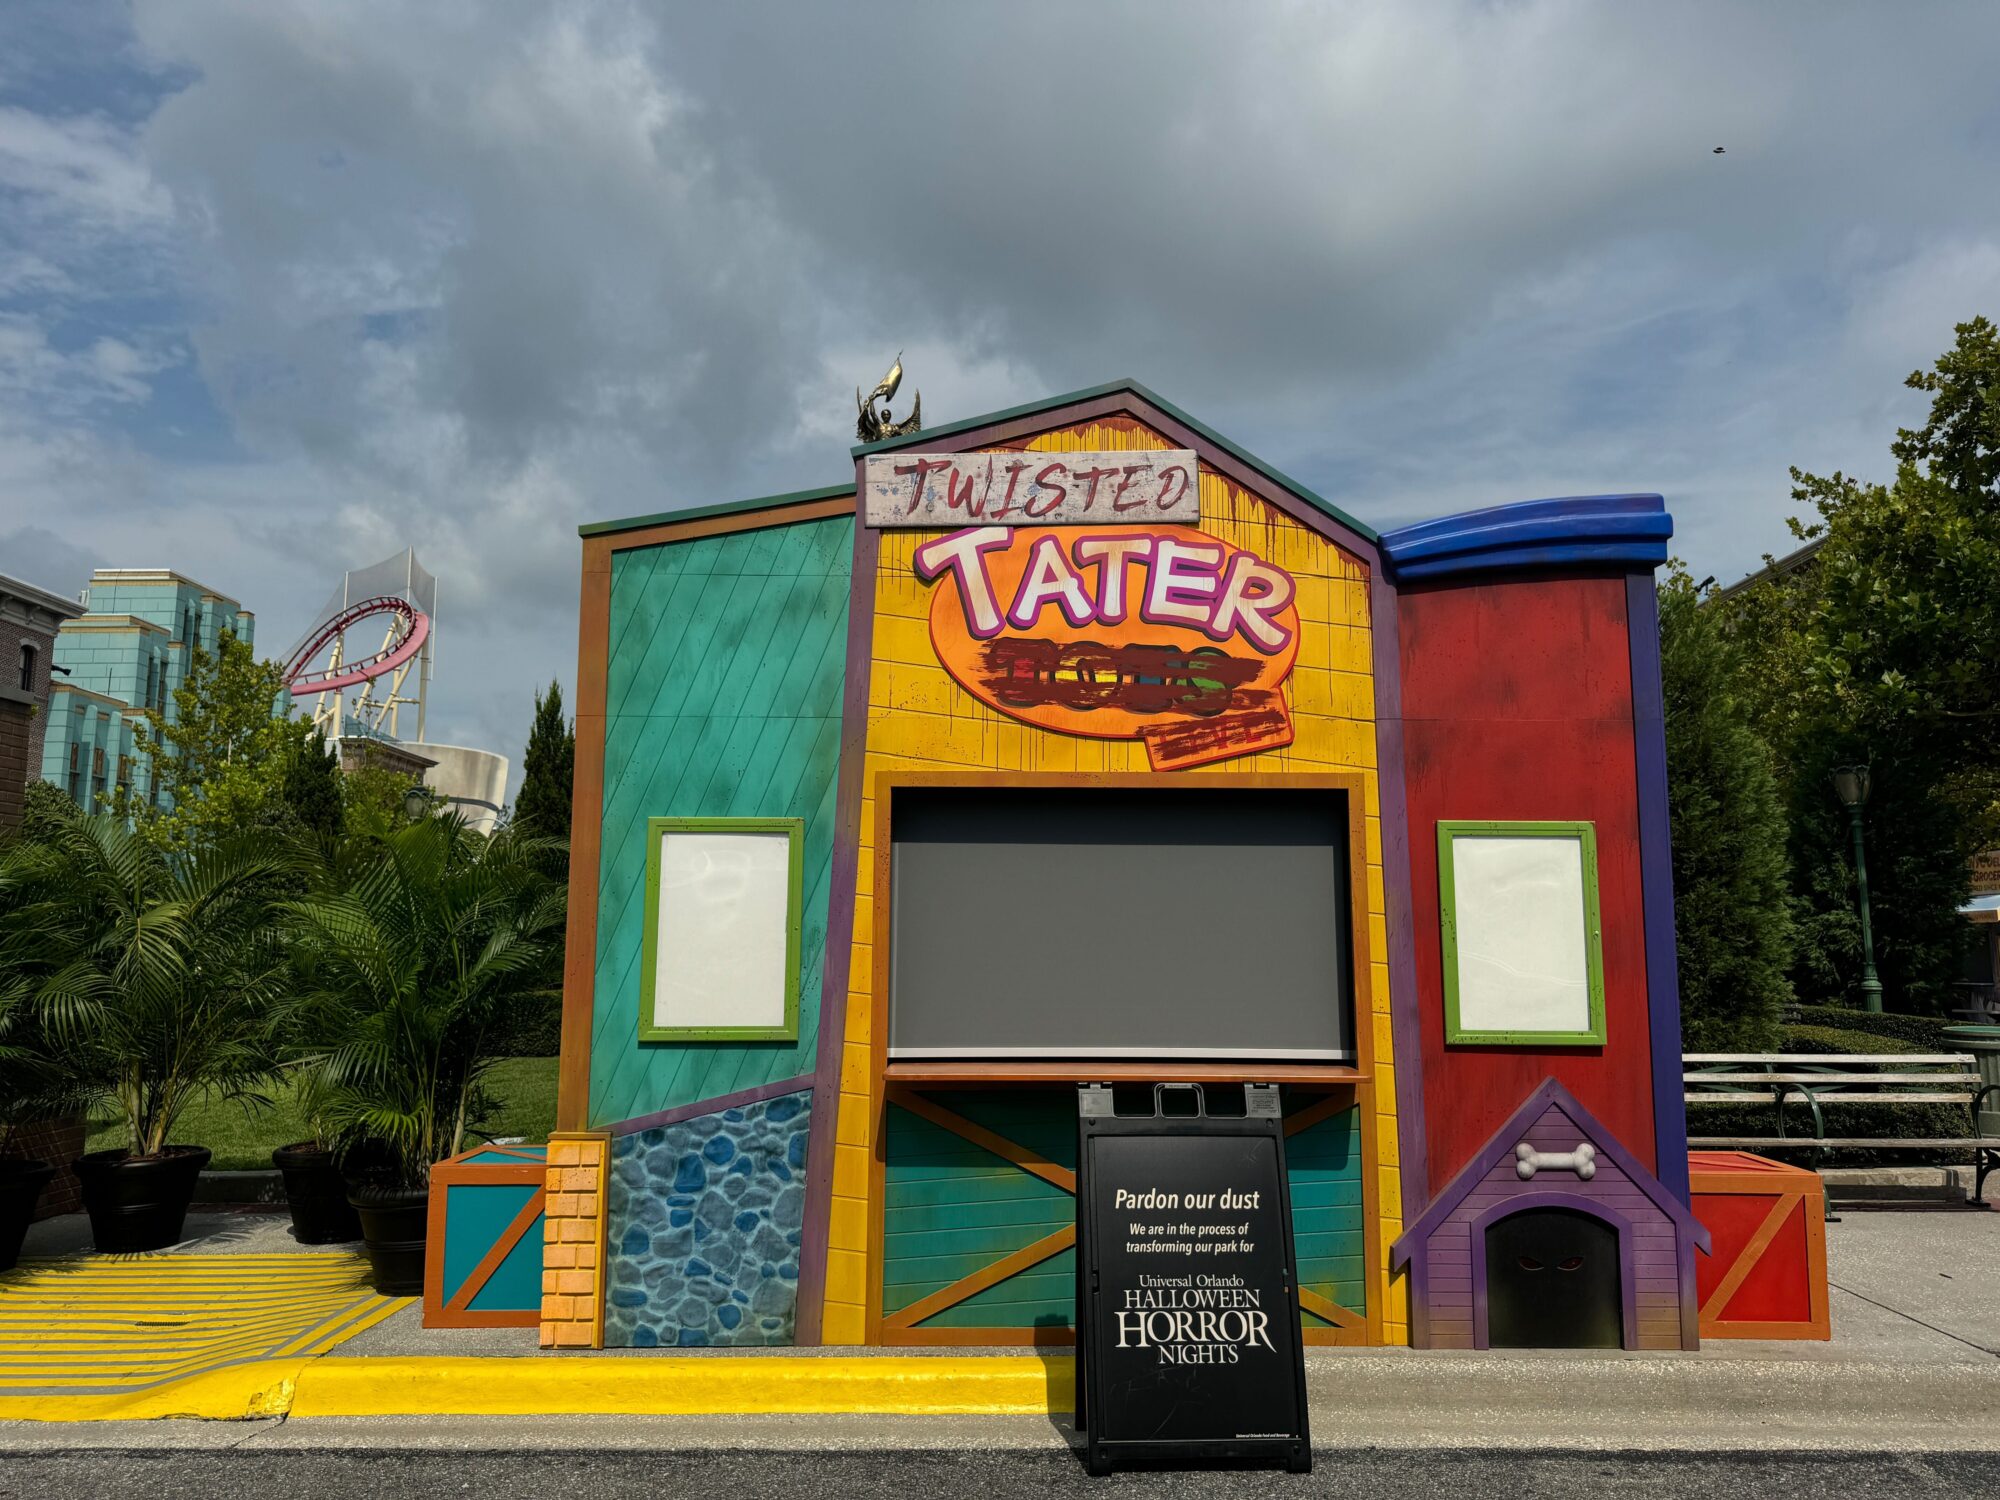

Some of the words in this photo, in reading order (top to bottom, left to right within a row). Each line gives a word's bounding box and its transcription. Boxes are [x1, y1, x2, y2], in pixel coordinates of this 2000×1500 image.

[894, 454, 1190, 521] TWISTED
[913, 527, 1297, 656] TATER
[1115, 1187, 1179, 1209] Pardon
[1184, 1193, 1216, 1209] our
[1219, 1187, 1260, 1209] dust
[1130, 1222, 1146, 1235] We
[1148, 1225, 1164, 1235] are
[1166, 1222, 1177, 1235] in
[1179, 1222, 1196, 1235] the
[1198, 1225, 1236, 1238] process
[1237, 1222, 1249, 1235] of
[1126, 1240, 1192, 1256] transforming
[1194, 1243, 1213, 1253] our
[1214, 1240, 1237, 1256] park
[1239, 1240, 1255, 1253] for
[1139, 1274, 1192, 1287] Universal
[1196, 1273, 1244, 1287] Orlando
[1123, 1288, 1260, 1309] HALLOWEEN
[1113, 1310, 1278, 1354] HORROR
[1158, 1343, 1239, 1364] NIGHTS
